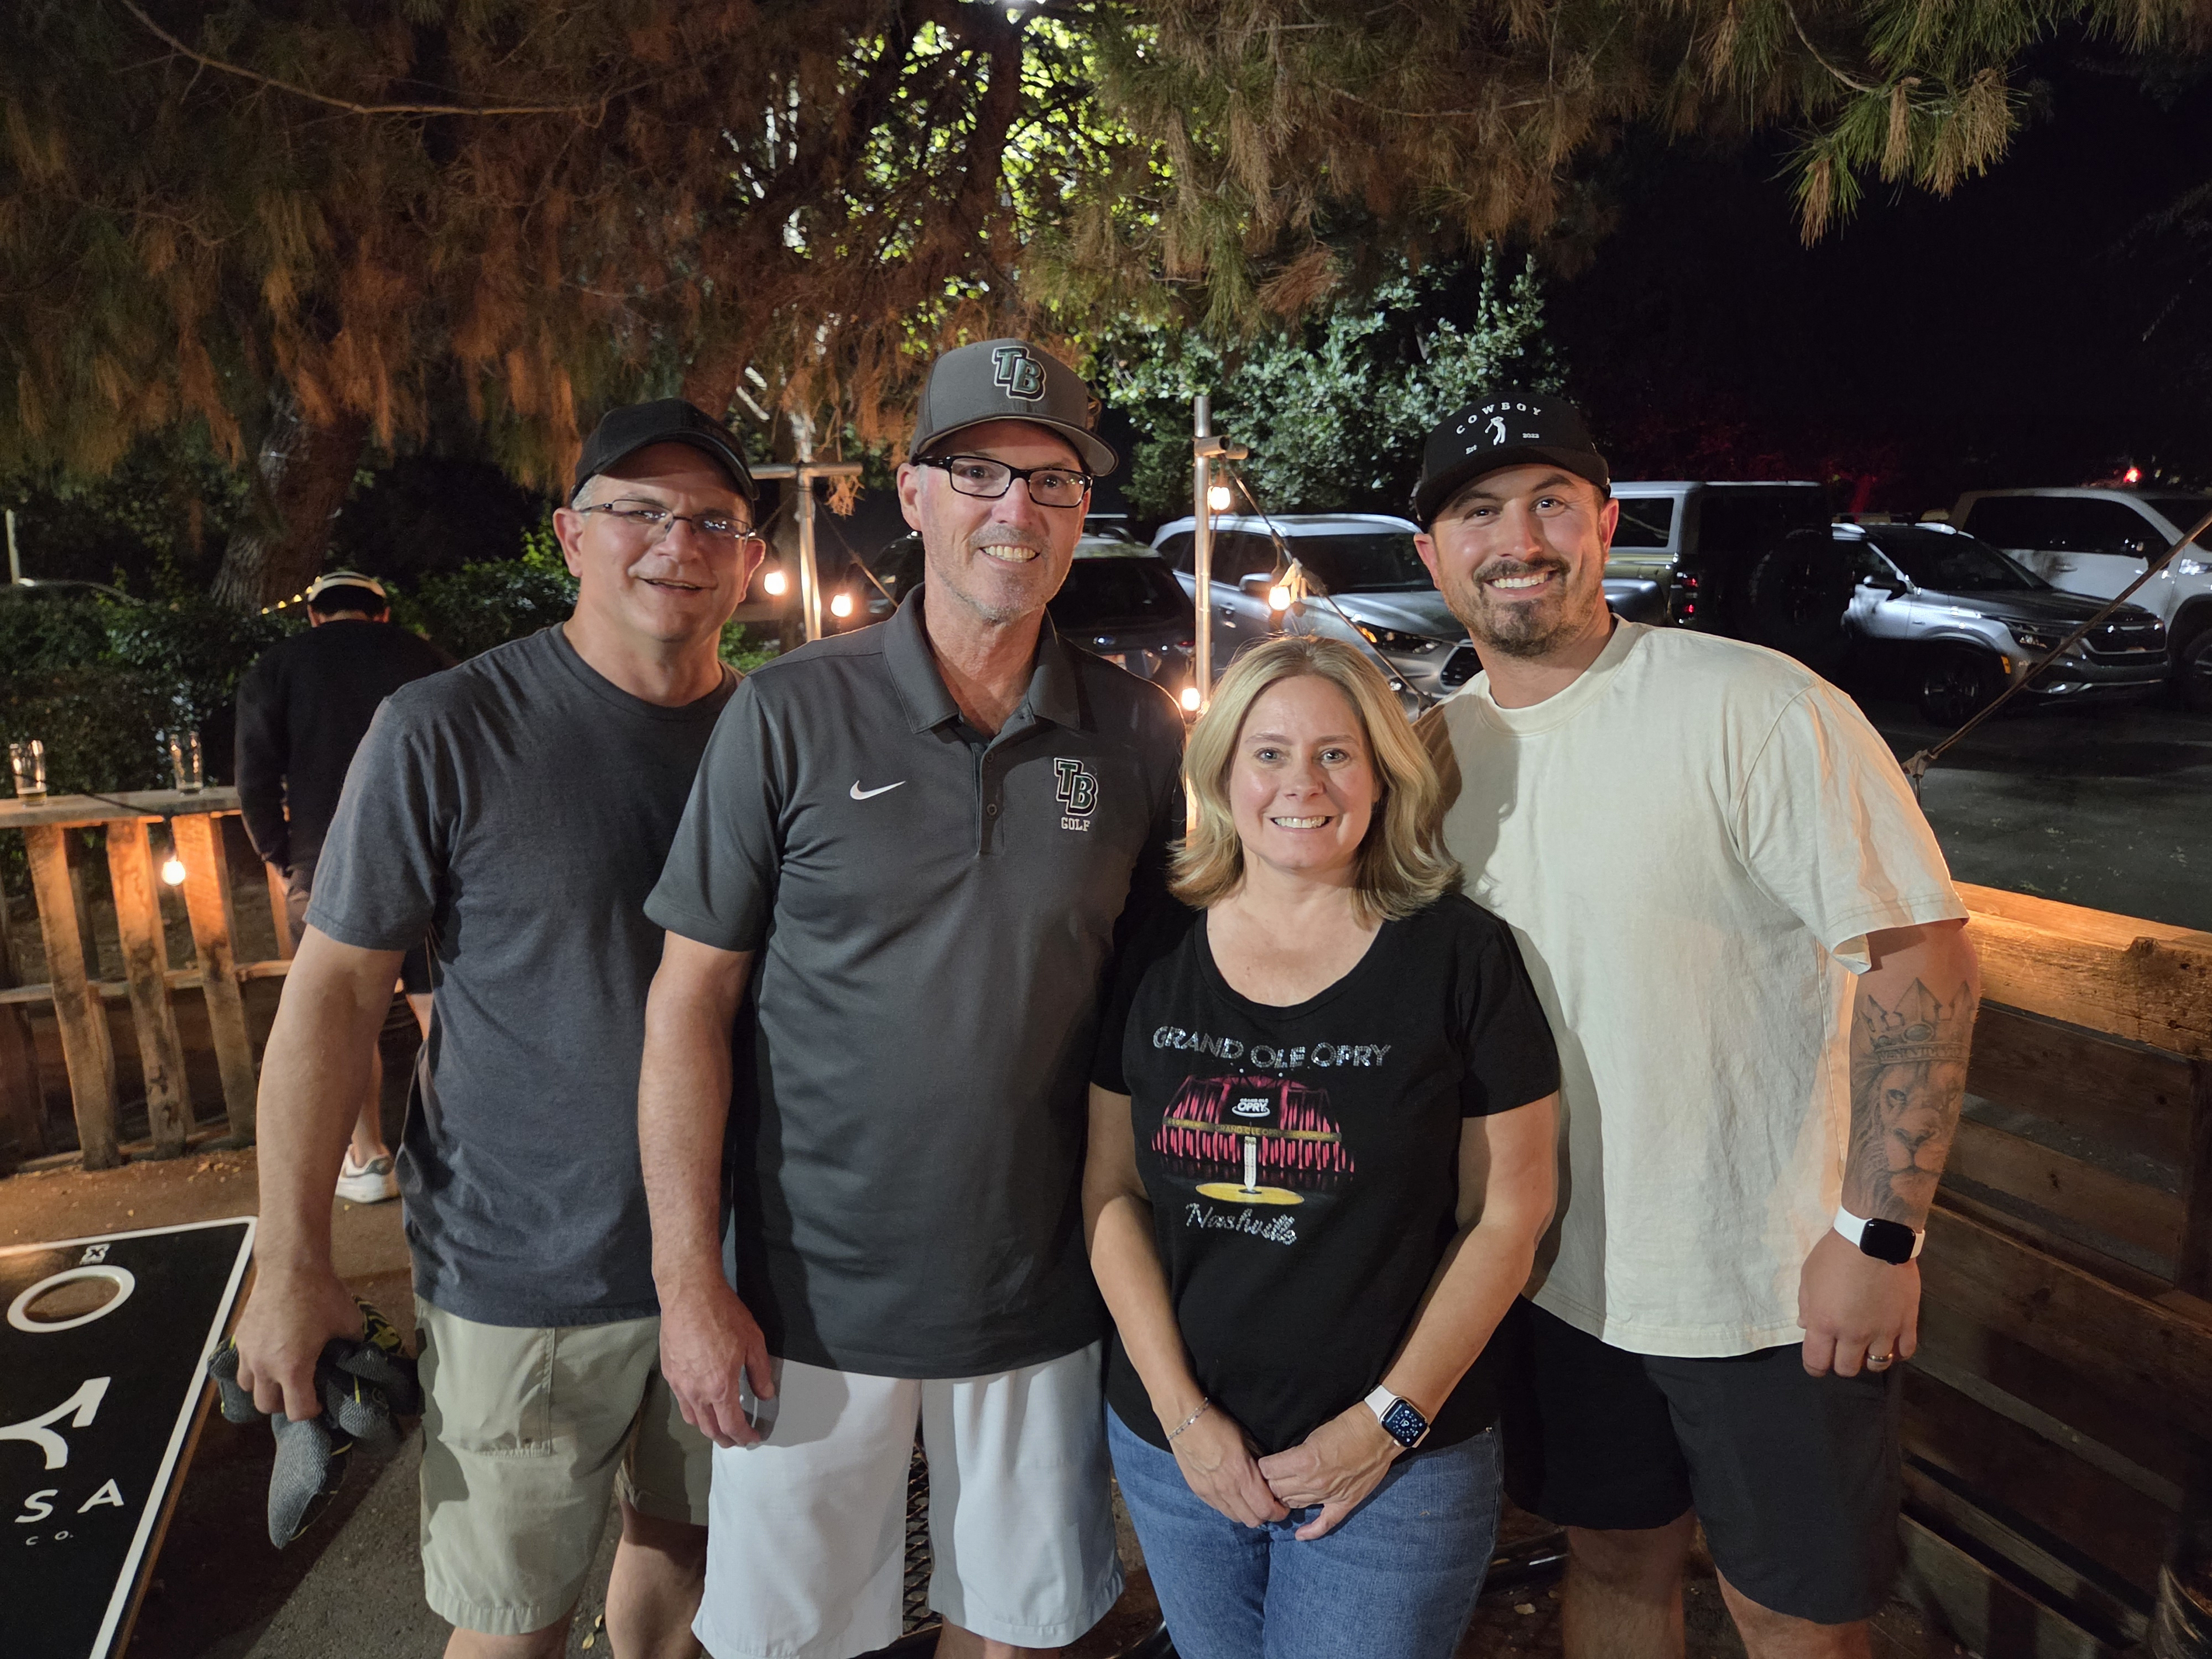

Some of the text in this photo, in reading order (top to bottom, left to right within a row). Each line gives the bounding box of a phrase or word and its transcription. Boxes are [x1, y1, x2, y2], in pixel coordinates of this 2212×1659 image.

[992, 346, 1046, 401] TB
[1456, 402, 1541, 434] COWBOY
[1053, 758, 1098, 816] TB
[1061, 816, 1091, 832] GOLF
[1152, 1026, 1391, 1068] GRAND OLE OPRY
[1214, 1124, 1243, 1133] GRAND
